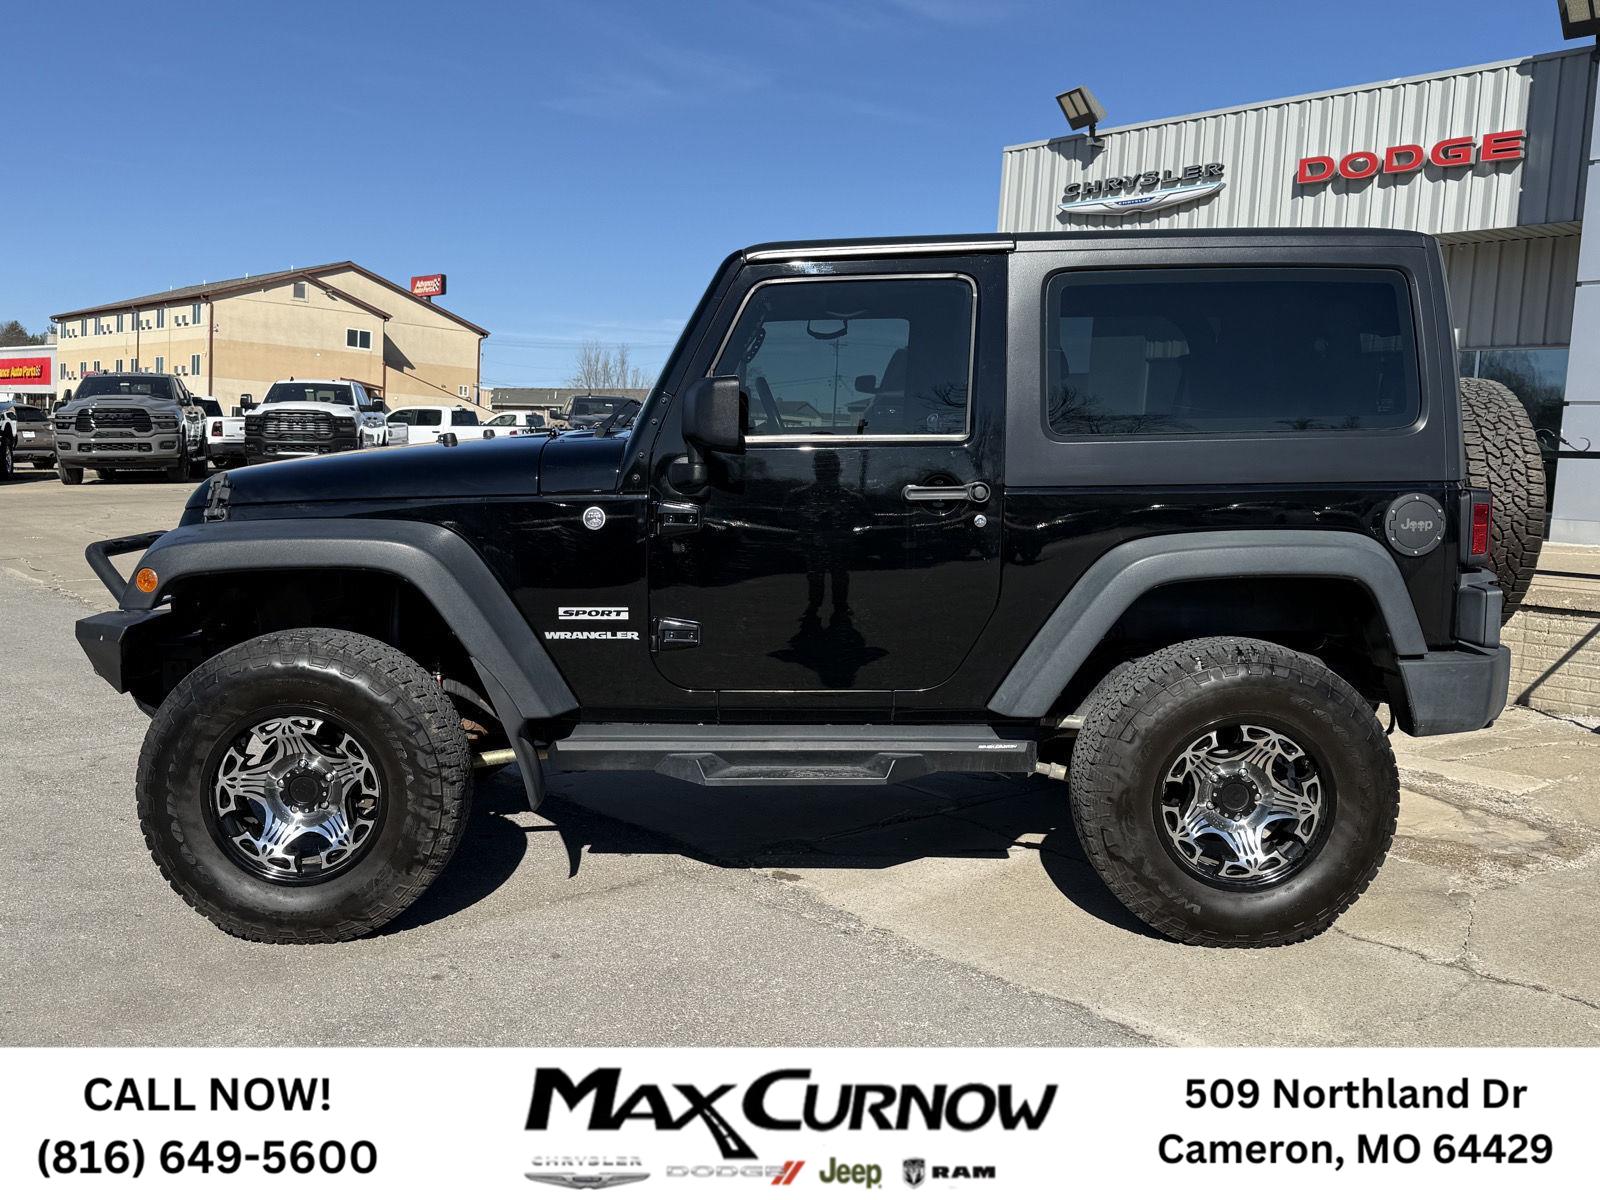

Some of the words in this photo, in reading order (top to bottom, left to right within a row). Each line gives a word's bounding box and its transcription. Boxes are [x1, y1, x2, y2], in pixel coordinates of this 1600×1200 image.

[1297, 129, 1526, 184] DODGE
[1063, 162, 1225, 197] CHRYSLER
[1401, 518, 1433, 532] Jeep
[562, 608, 627, 618] SPORT
[544, 631, 640, 641] WRANGLER
